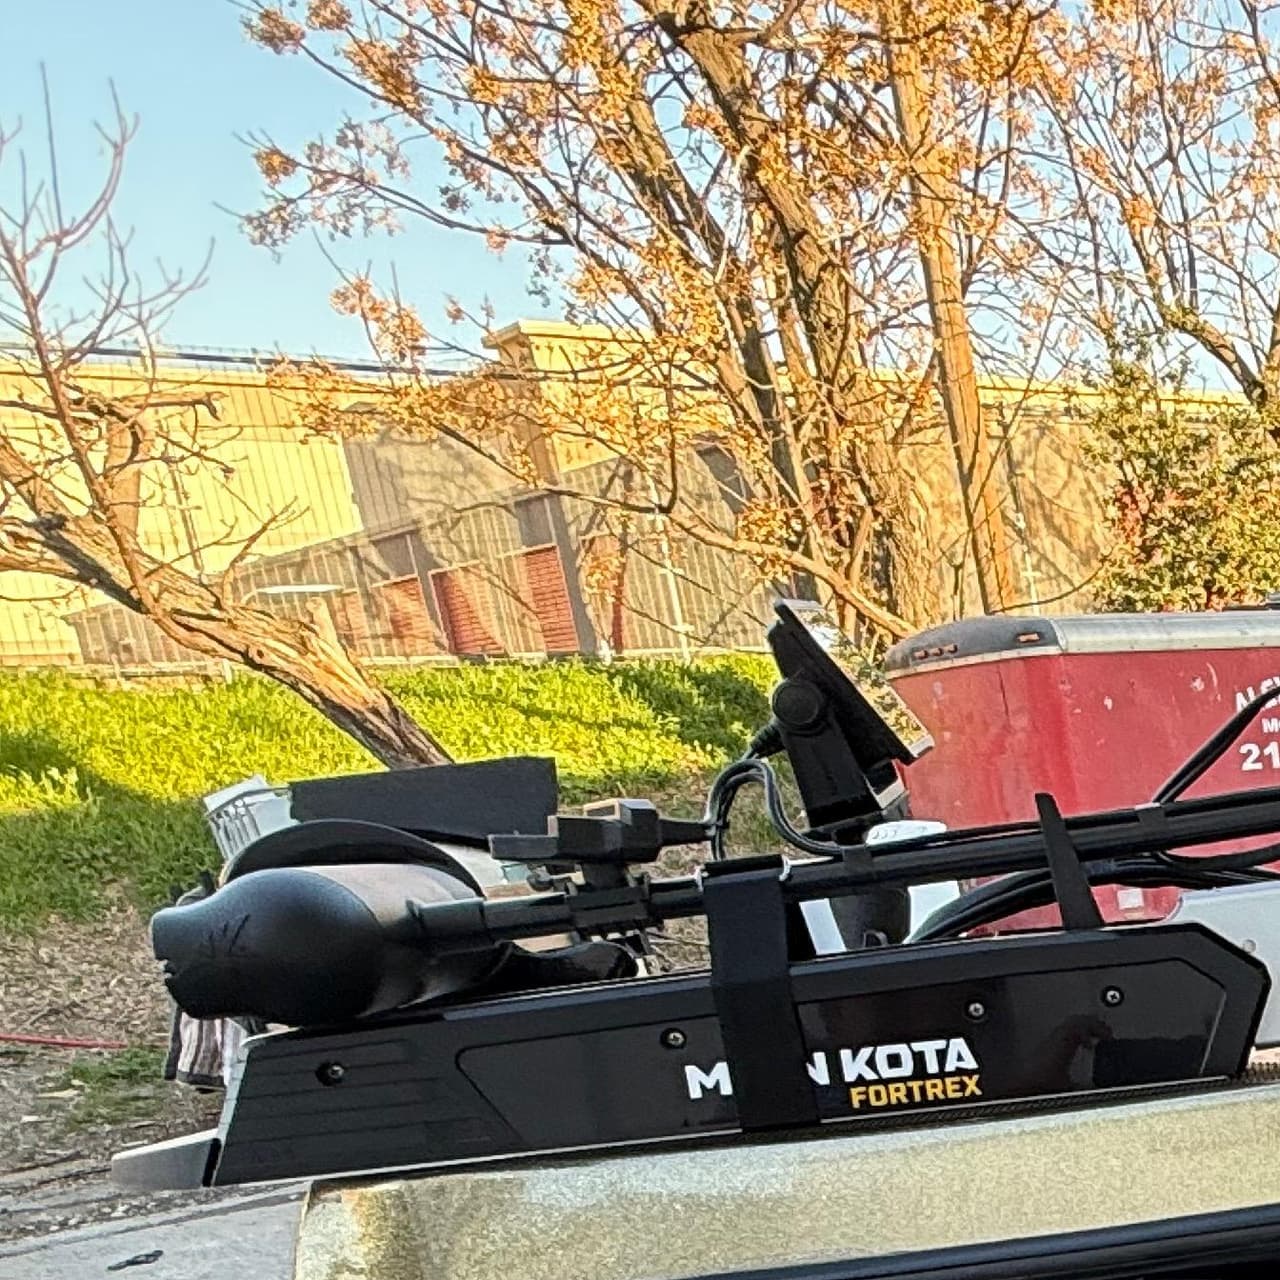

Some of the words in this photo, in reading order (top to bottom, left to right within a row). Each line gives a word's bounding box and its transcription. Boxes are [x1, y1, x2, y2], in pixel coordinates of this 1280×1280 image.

[684, 1051, 830, 1099] MN
[840, 1037, 979, 1082] KOTA
[850, 1074, 983, 1109] FORTREX
